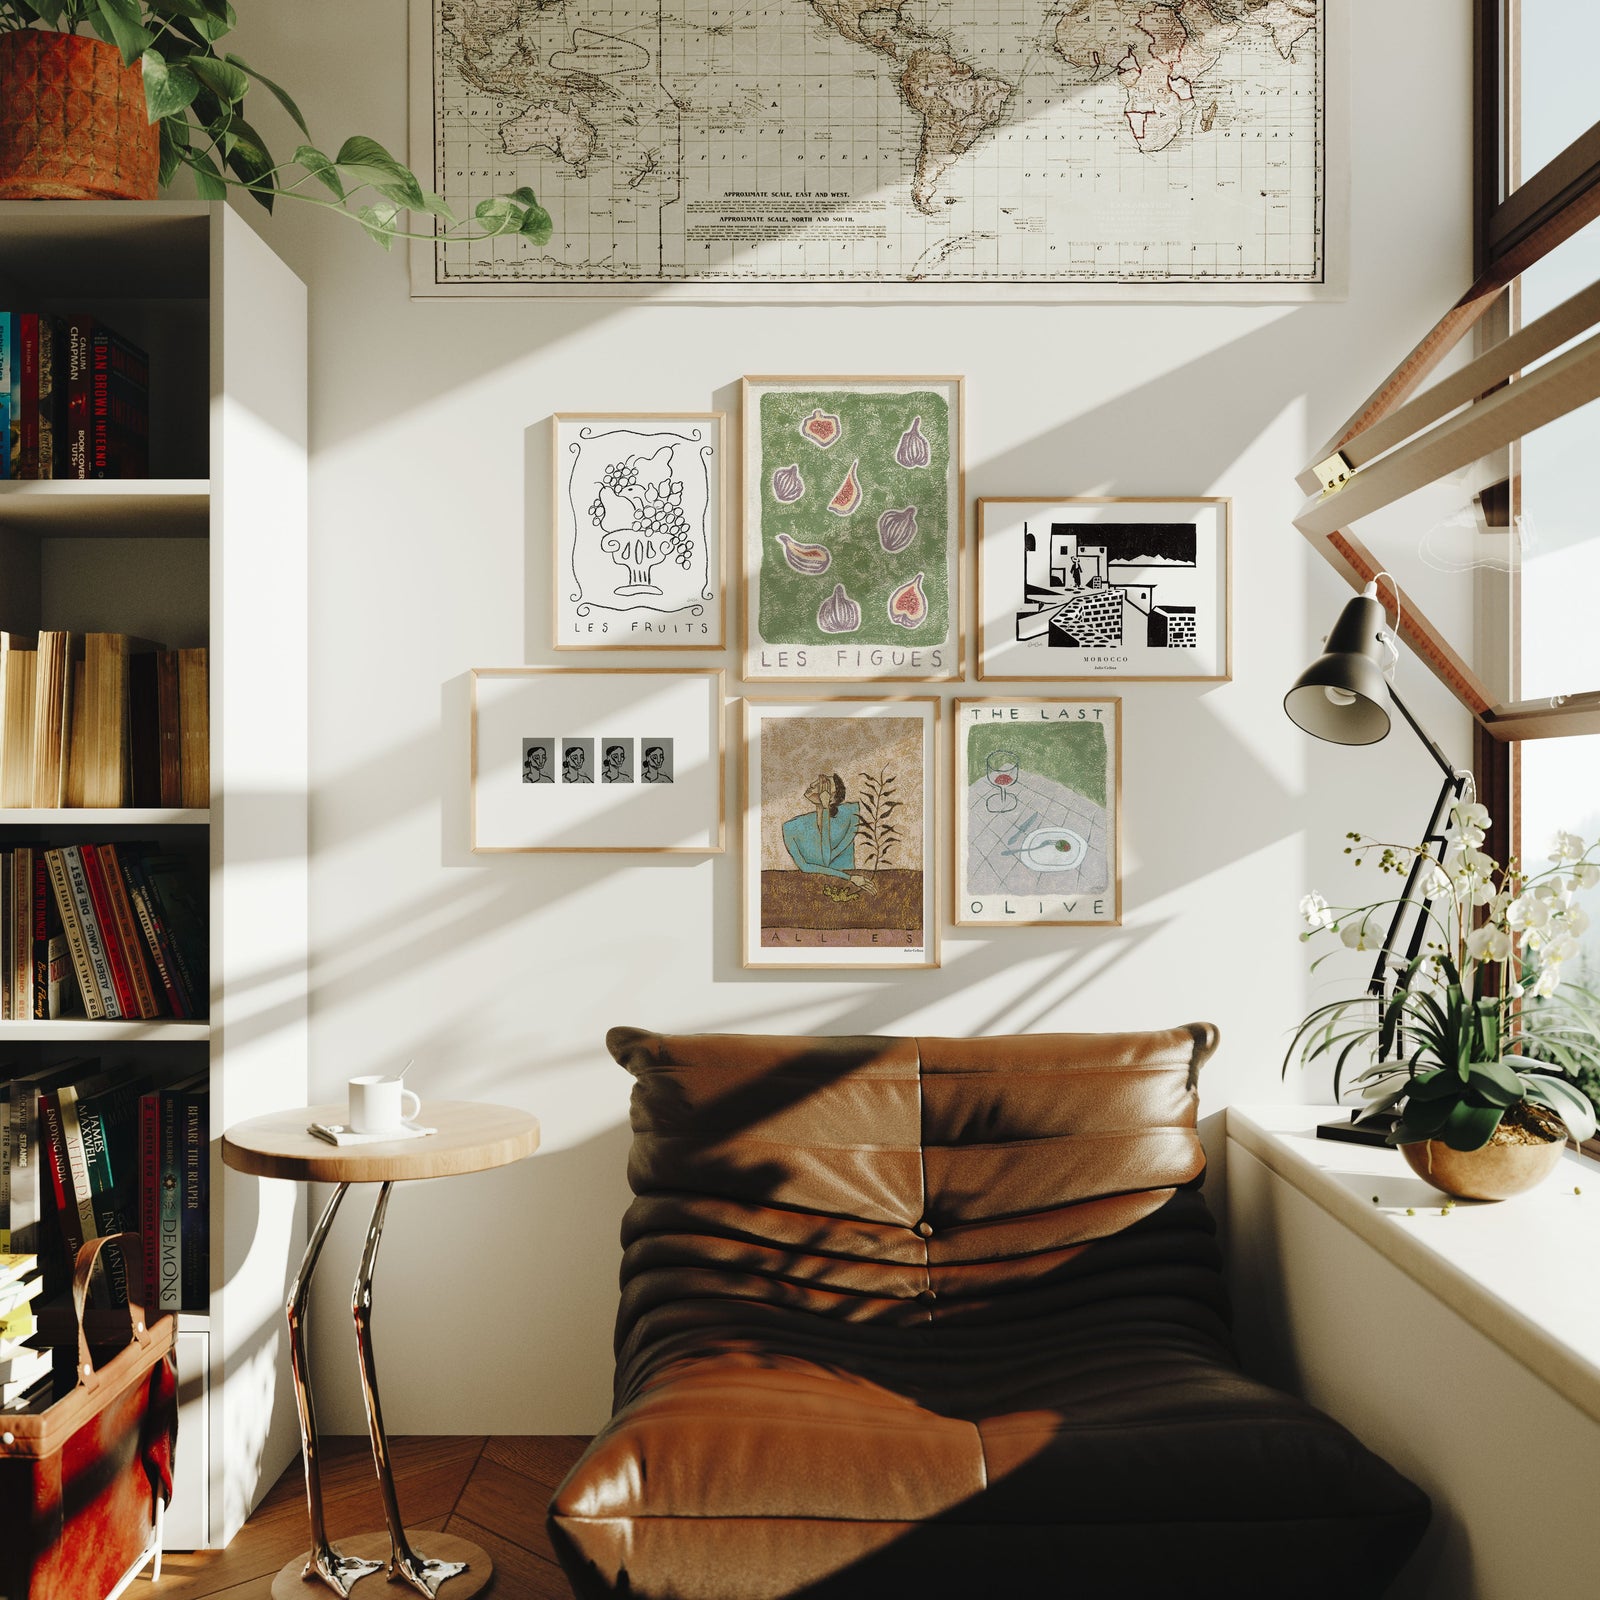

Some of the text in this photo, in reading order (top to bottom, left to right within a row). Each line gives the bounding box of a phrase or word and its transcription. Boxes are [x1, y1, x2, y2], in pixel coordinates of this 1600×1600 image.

[70, 326, 79, 381] CHAPMAN
[95, 346, 107, 370] DAN
[95, 374, 107, 416] BROWN
[96, 420, 106, 467] INFERNO
[574, 621, 708, 633] LES FRUITS
[761, 649, 942, 668] LES FIGUES
[971, 708, 1103, 720] THE LAST
[54, 866, 65, 886] FRAU
[71, 865, 86, 895] PEST
[36, 859, 46, 941] DEADLINE TO DANGER
[79, 901, 91, 917] DIE
[971, 900, 1103, 914] OLIVE
[69, 916, 77, 929] DIE
[73, 938, 85, 960] BUCK
[85, 923, 100, 955] CAMUS
[771, 932, 913, 944] ALLIES
[37, 960, 47, 983] Brad
[97, 958, 110, 989] ALBERT
[158, 963, 171, 989] BROKEN
[166, 1098, 174, 1124] BRETT
[187, 1105, 198, 1145] BEWARE
[46, 1108, 67, 1184] ENJOYNG INDIA
[78, 1105, 97, 1166] MAXWELL
[89, 1115, 105, 1153] JAMES
[19, 1133, 28, 1168] STRANGE
[187, 1148, 198, 1168] THE
[66, 1136, 93, 1221] AFTER DAYS
[187, 1171, 198, 1209] REAPER
[163, 1201, 176, 1210] SIX
[161, 1219, 179, 1302] DEMONS
